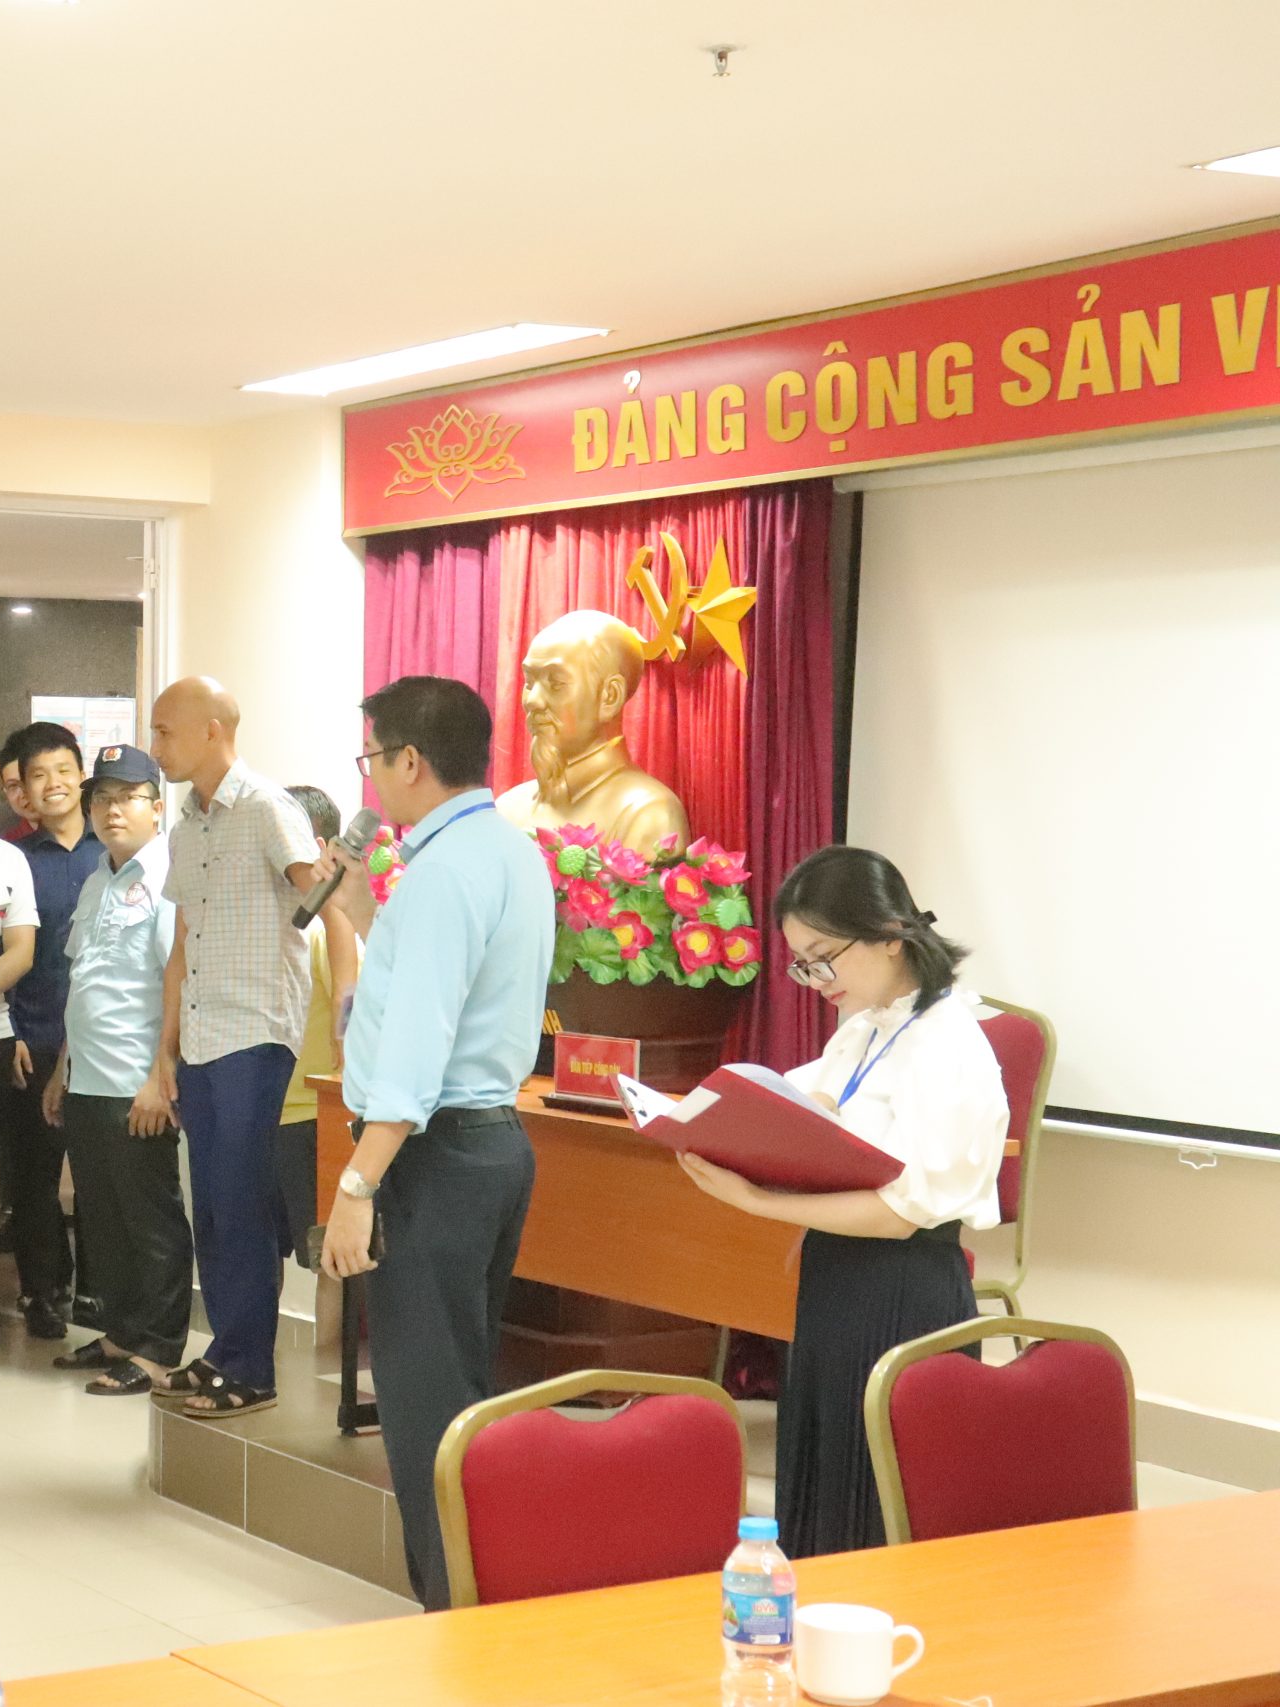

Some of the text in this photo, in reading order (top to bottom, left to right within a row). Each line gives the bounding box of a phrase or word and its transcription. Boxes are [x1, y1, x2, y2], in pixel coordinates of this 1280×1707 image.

[570, 283, 1280, 474] ĐẢNG CỘNG SẢN V
